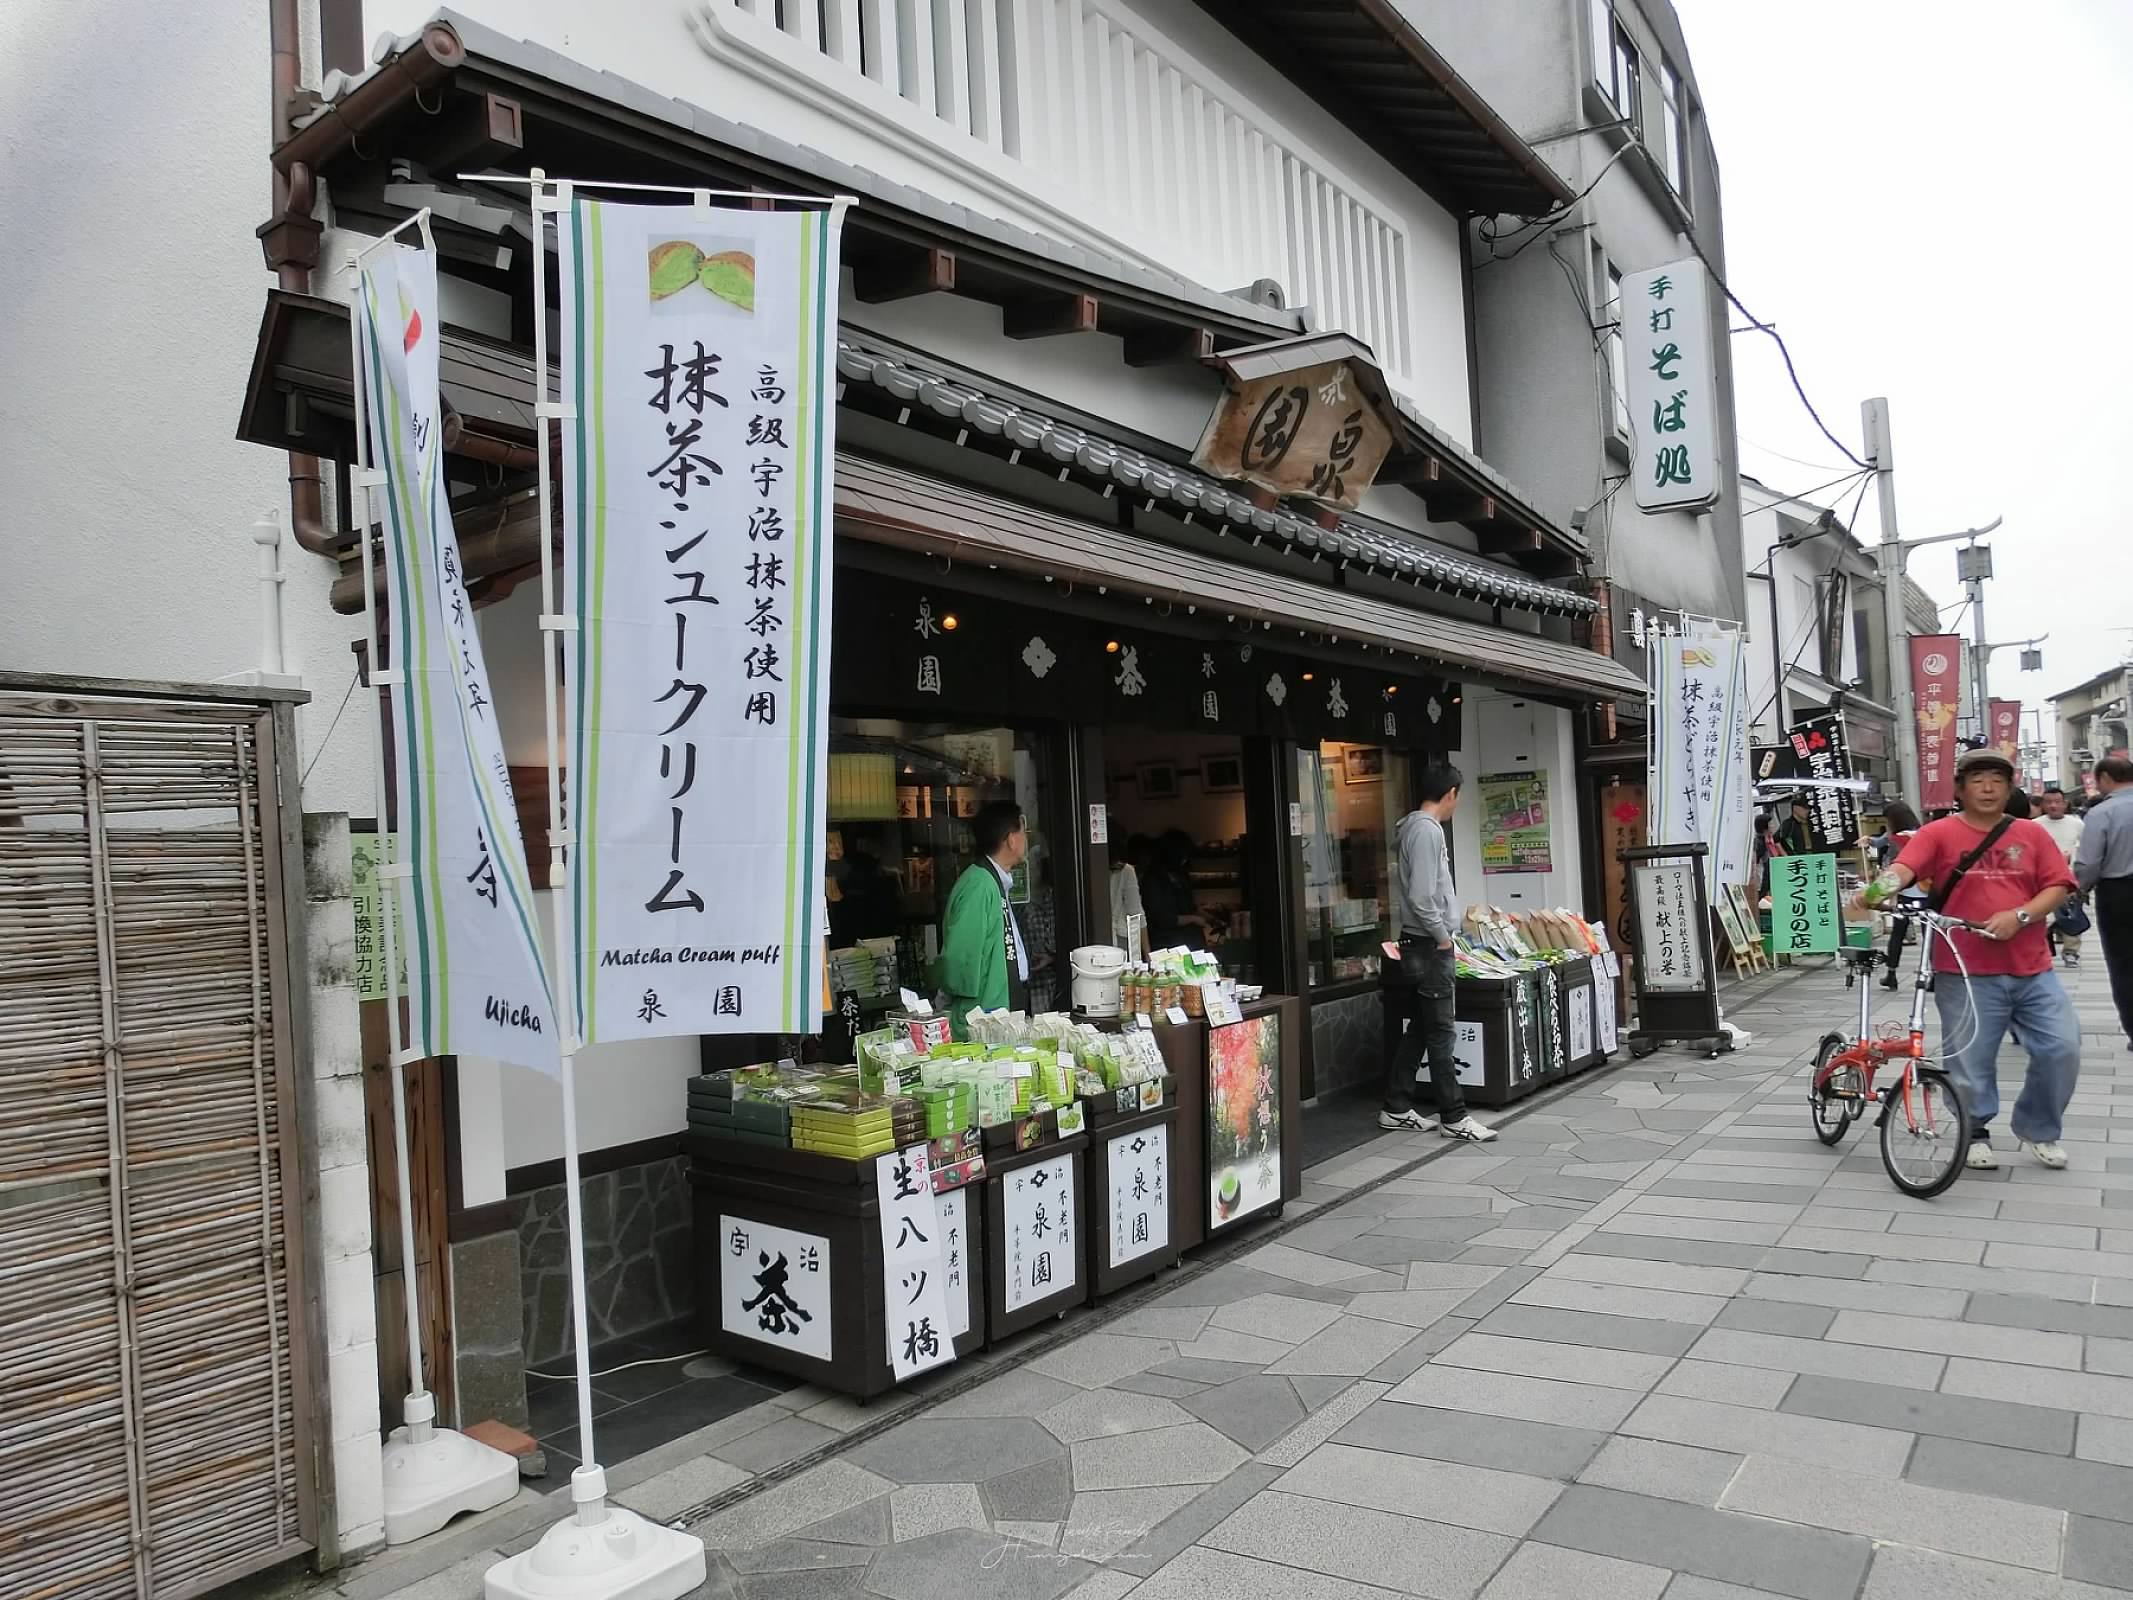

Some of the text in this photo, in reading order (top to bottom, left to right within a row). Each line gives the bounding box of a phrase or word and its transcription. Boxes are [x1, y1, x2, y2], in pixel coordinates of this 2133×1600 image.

[1648, 275, 1692, 488] 手打そば処
[743, 363, 789, 726] 高級宇治抹茶使用
[914, 596, 942, 695] 泉園
[353, 896, 373, 994] 引換協力店
[1786, 859, 1812, 949] 手づくりの店
[600, 944, 780, 969] Matcha Cream puff
[485, 995, 542, 1034] Ujicha
[914, 1154, 929, 1193] 京の
[1132, 1167, 1149, 1245] 泉園
[730, 1226, 819, 1273] 宇 治
[893, 1158, 940, 1366] 生八ツ橋
[1031, 1202, 1052, 1287] 泉園
[741, 1247, 814, 1336] 茶
